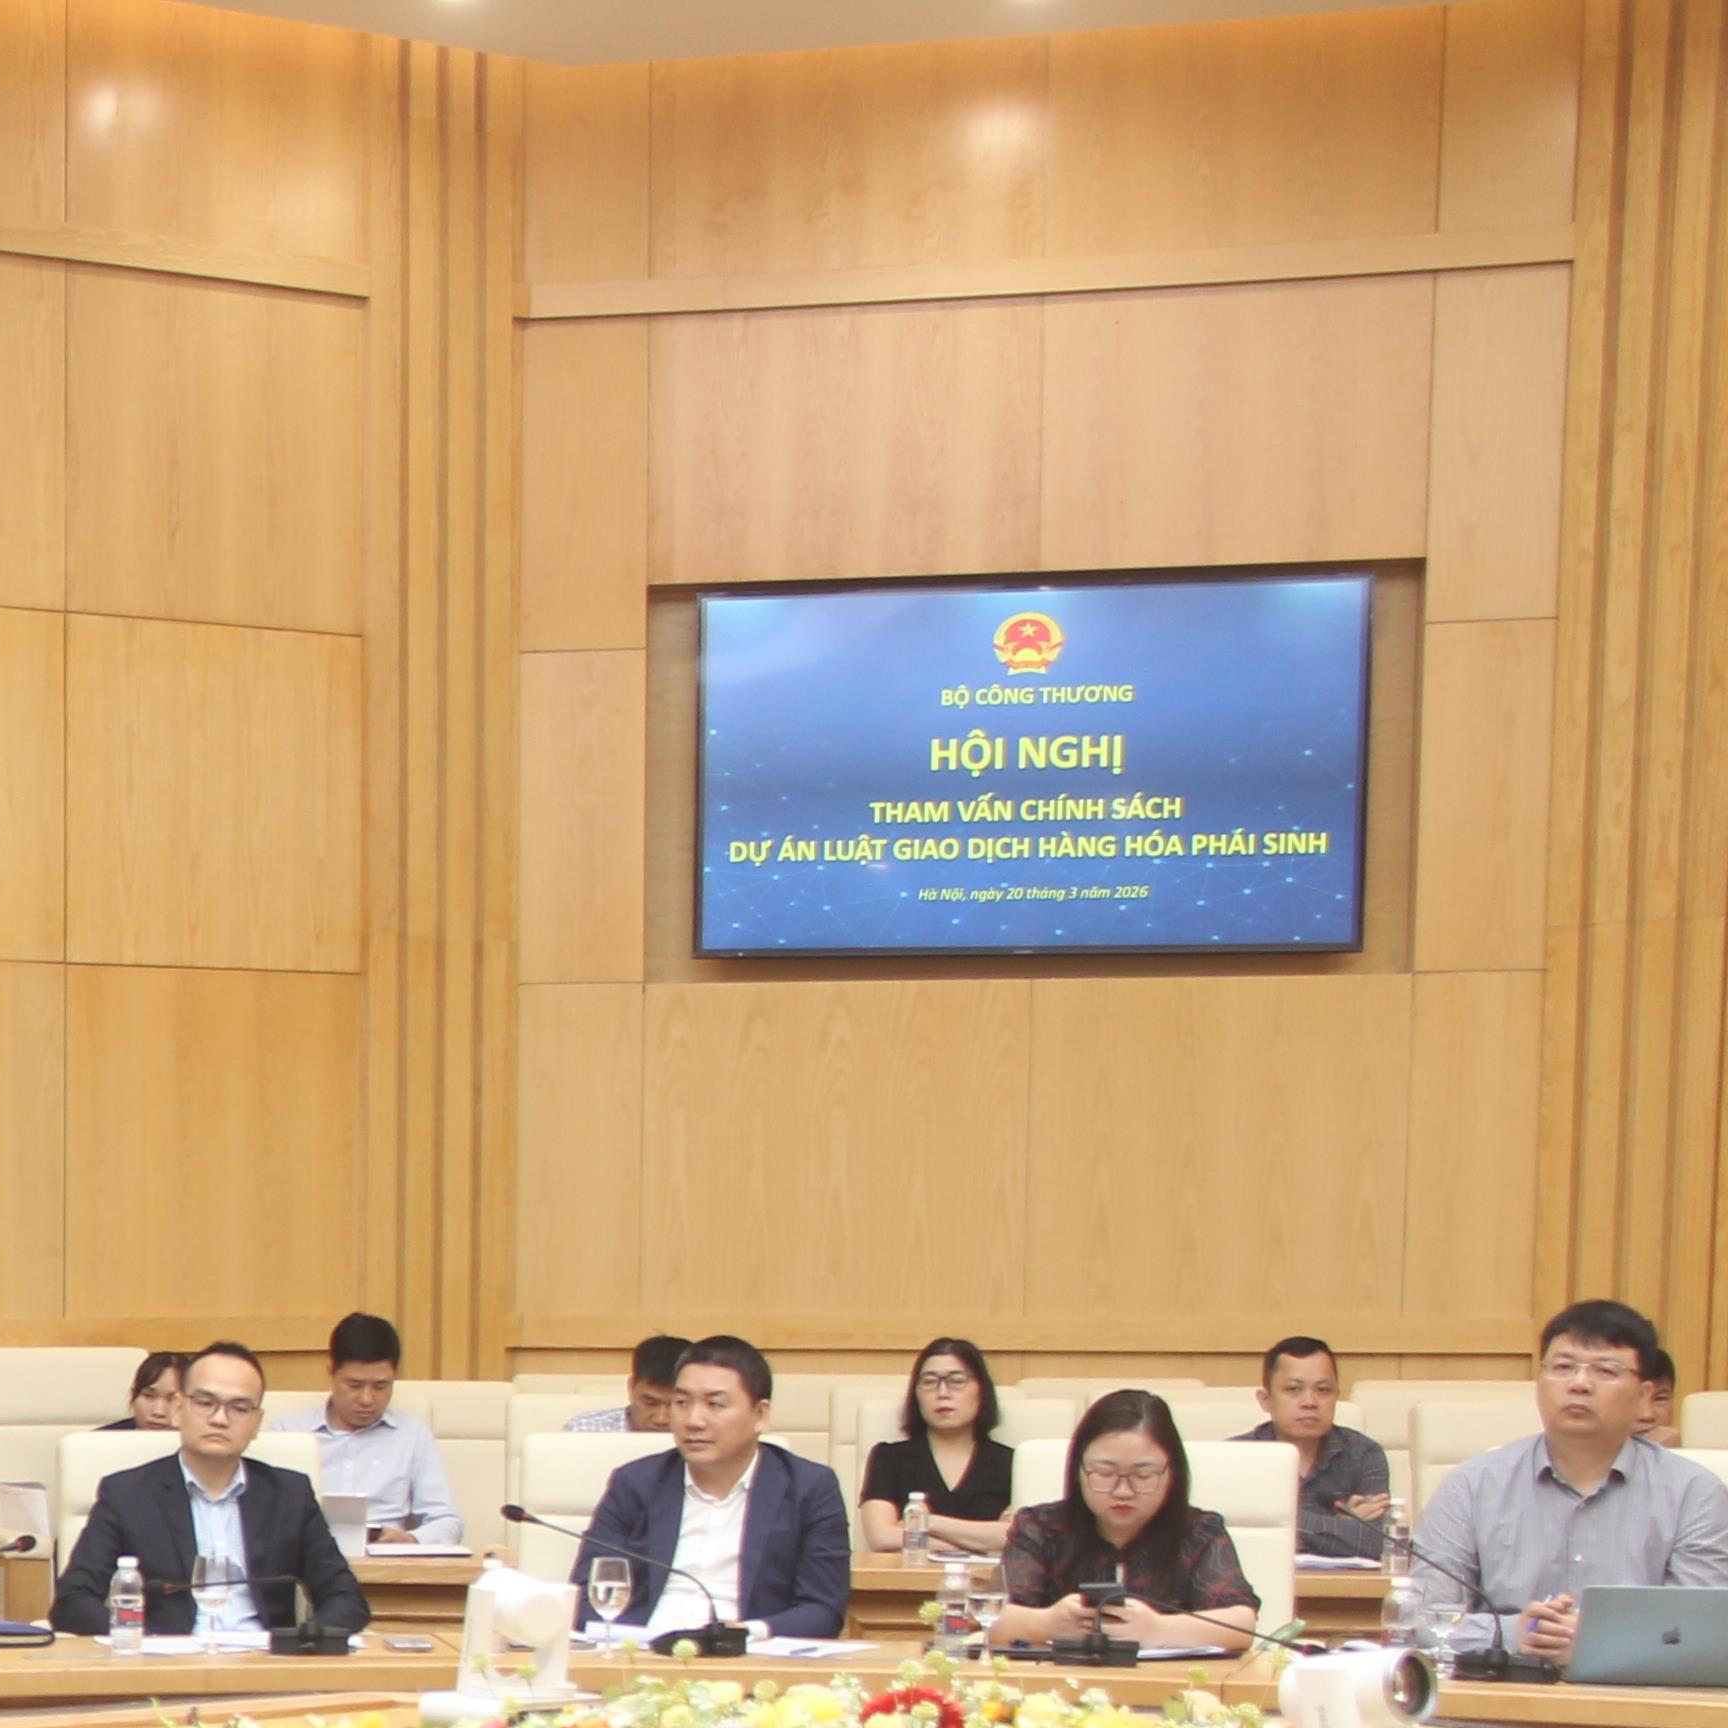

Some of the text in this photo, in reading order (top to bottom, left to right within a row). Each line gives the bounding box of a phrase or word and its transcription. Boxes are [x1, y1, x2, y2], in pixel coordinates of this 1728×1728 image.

[940, 683, 1134, 708] BỘ CÔNG THƯƠNG
[930, 729, 1124, 777] HỘI NGHỊ
[870, 792, 1183, 823] THAM VẤN CHÍNH SÁCH
[729, 829, 1329, 866] DỰ ÁN LUẬT GIAO DỊCH HÀNG HÓA PHÁI SINH
